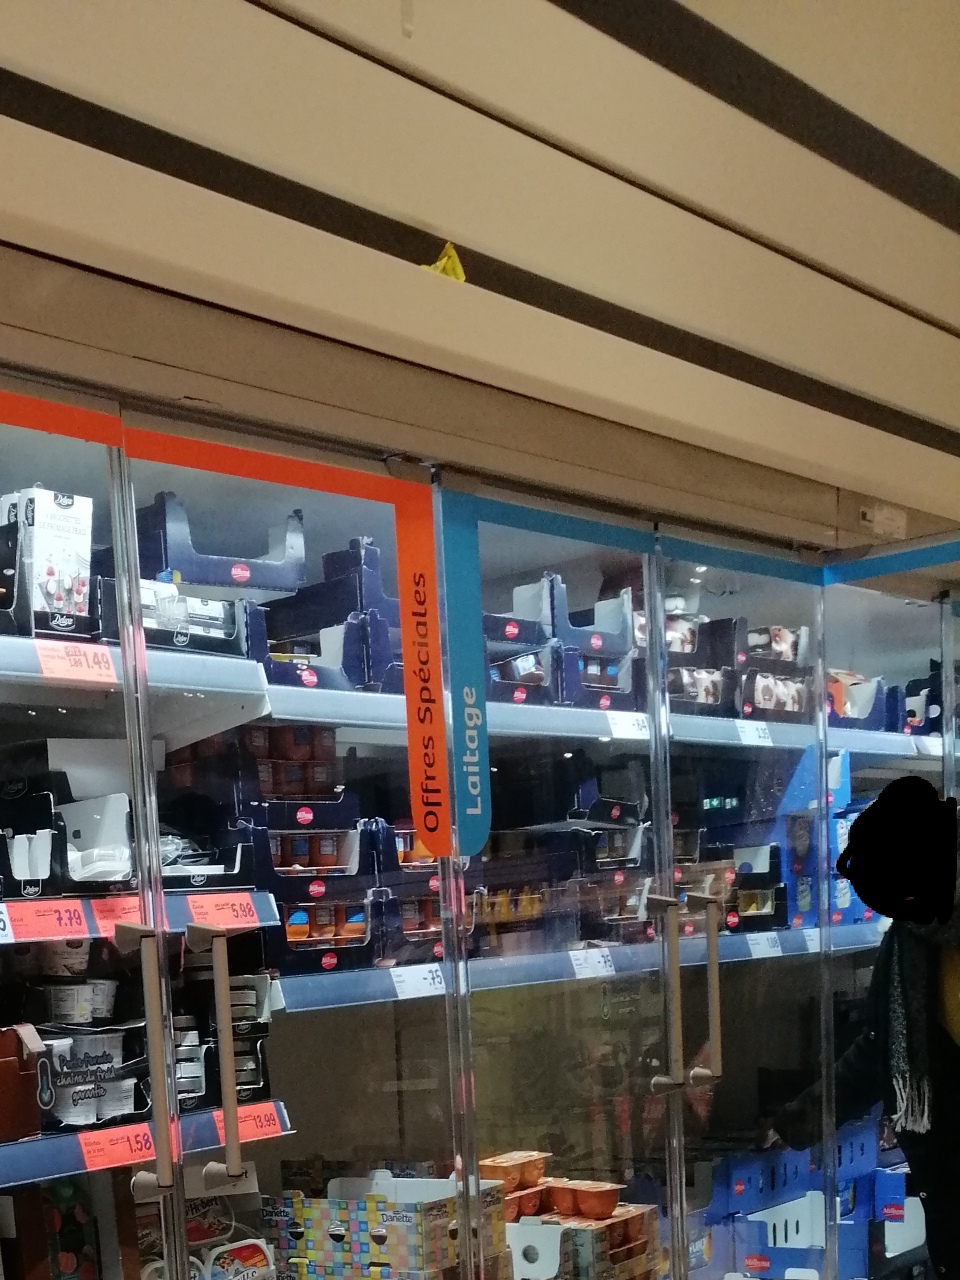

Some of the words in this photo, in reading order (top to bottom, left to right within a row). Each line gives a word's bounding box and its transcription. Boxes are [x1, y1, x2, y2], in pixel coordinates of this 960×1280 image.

[411, 572, 436, 724] Spéciales
[83, 650, 112, 671] 1.49
[462, 685, 482, 815] Laitage
[421, 735, 443, 833] Offres
[53, 908, 83, 928] 7.79
[230, 902, 255, 919] 5.98
[96, 1065, 116, 1081] froid
[71, 1084, 107, 1106] garantie
[253, 1112, 277, 1130] 13.99
[126, 1134, 153, 1154] 1.58
[261, 1208, 290, 1219] Danette
[381, 1212, 414, 1224] Danette
